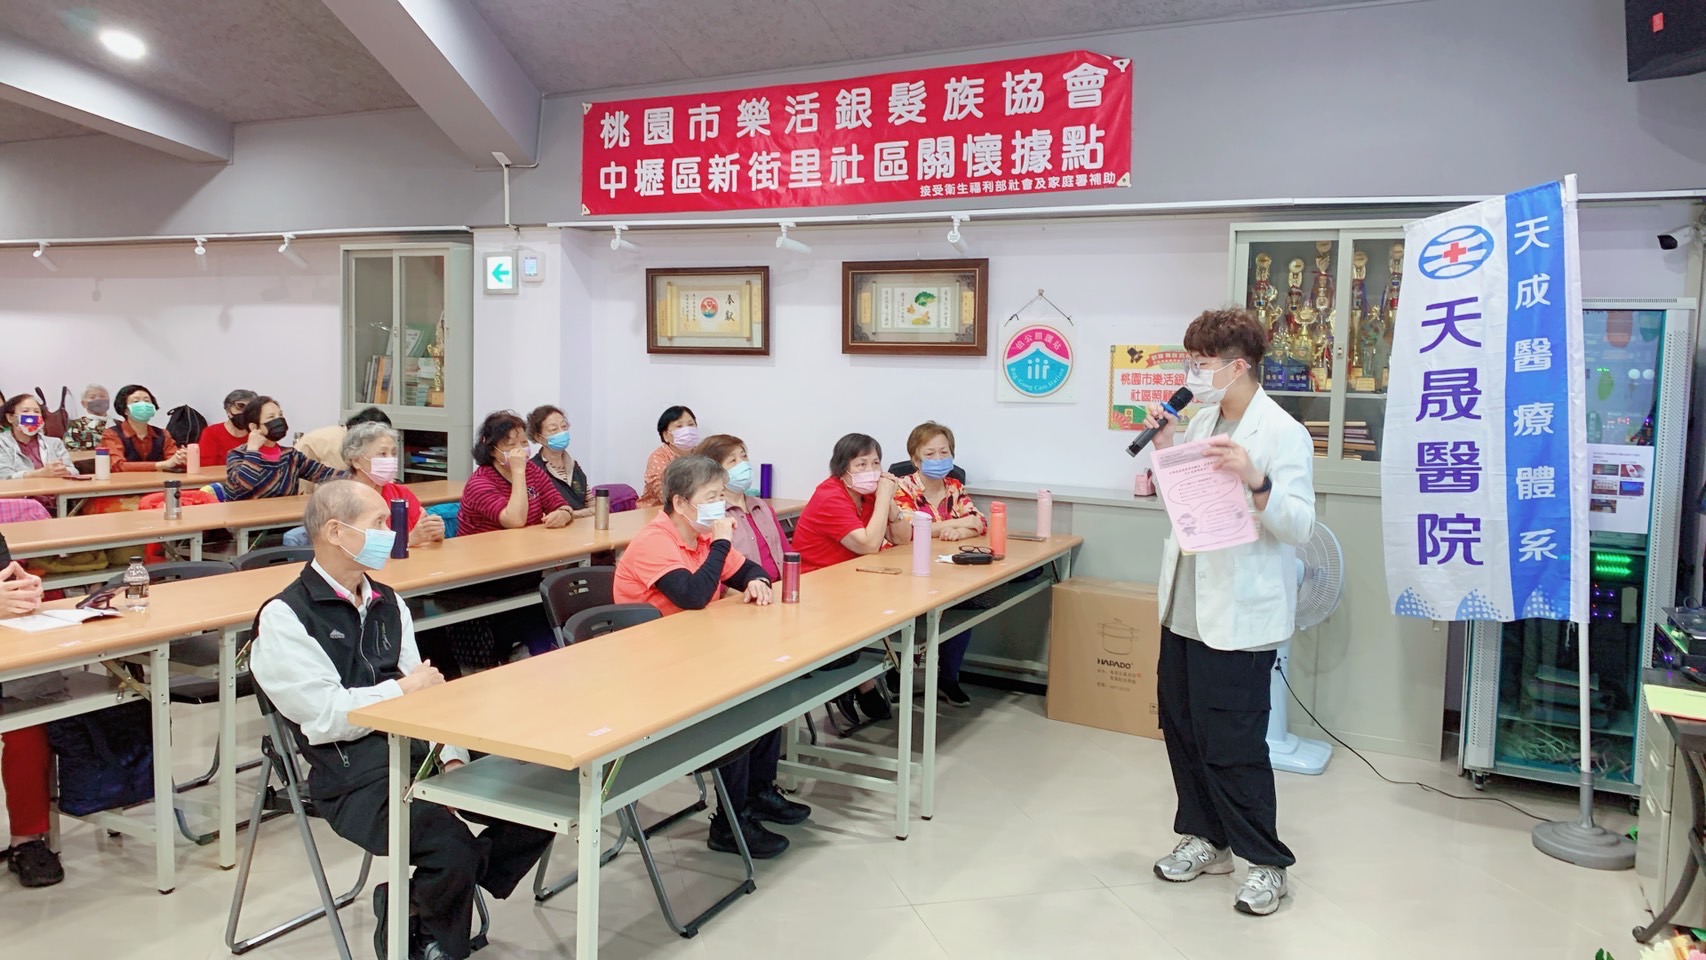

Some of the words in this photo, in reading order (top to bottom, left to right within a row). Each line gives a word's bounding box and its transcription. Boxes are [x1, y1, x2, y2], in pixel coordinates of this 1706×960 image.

[600, 62, 1109, 149] 桃園市樂活銀髮族協會
[599, 124, 1106, 199] 中壢區新街里社區關懷據點
[919, 171, 1117, 197] 接受衛生福利部社會及家庭署補助
[1415, 296, 1484, 566] 天晟醫院
[1513, 215, 1559, 562] 天成醫療體系
